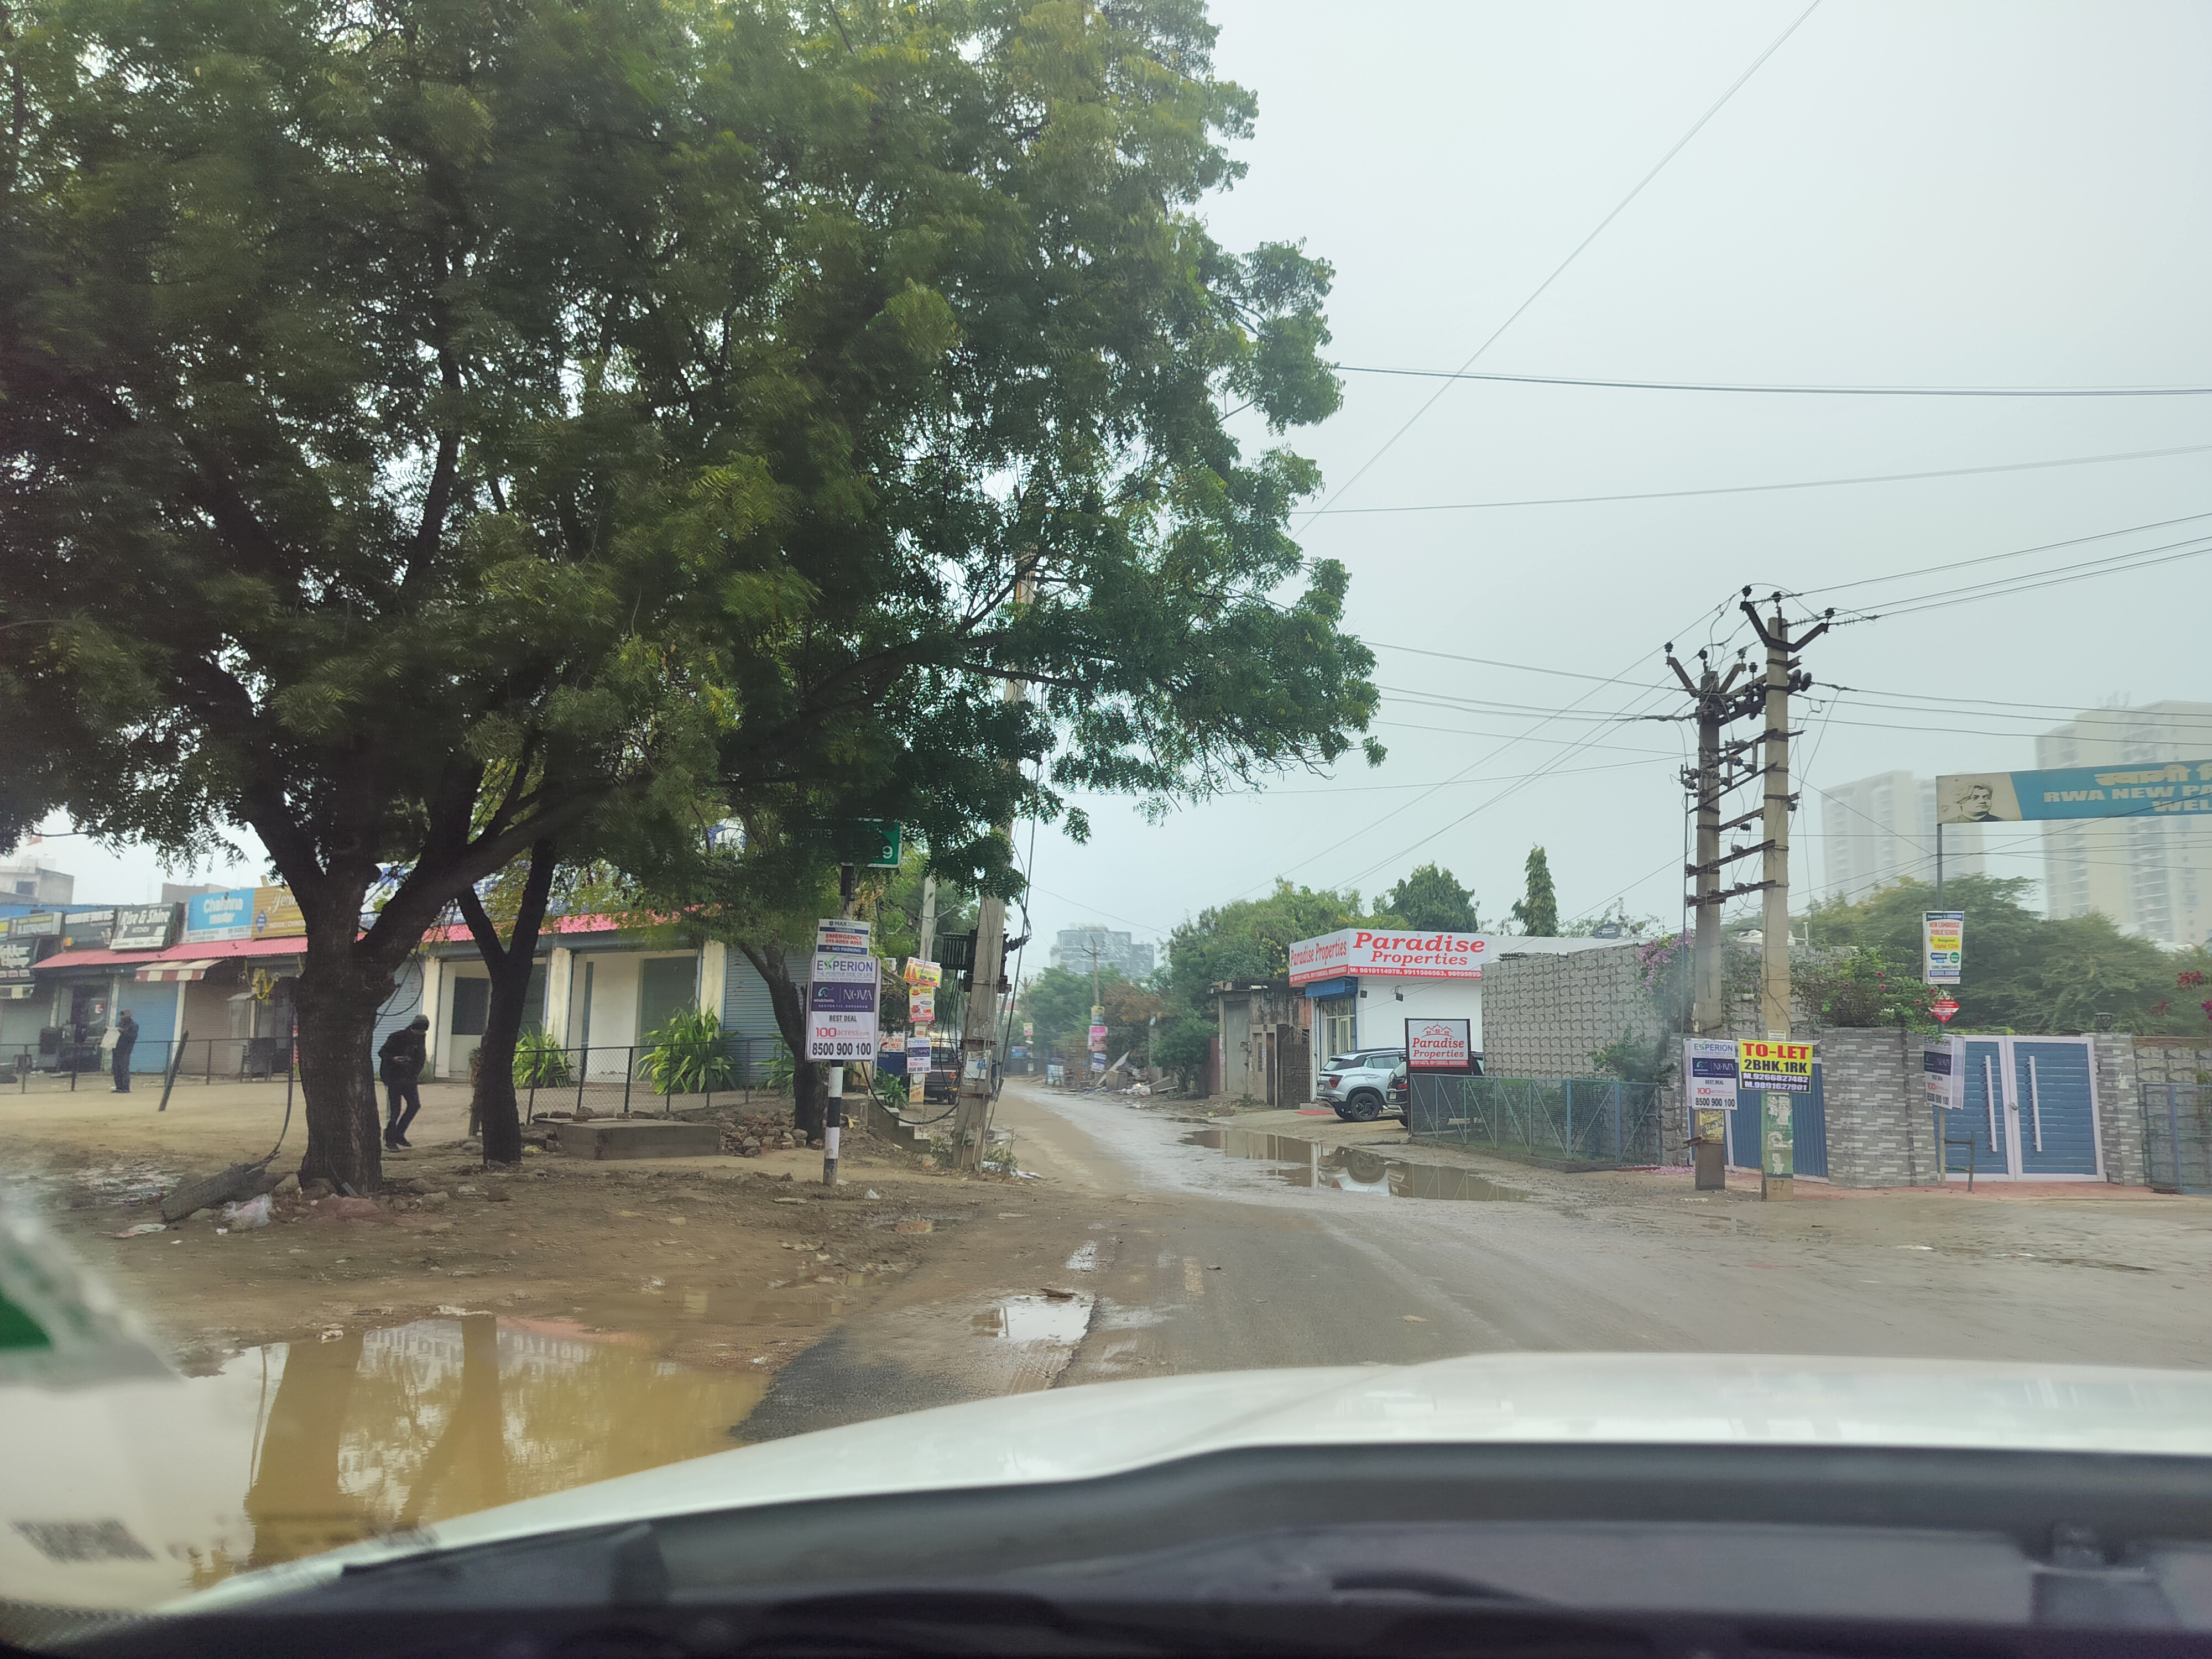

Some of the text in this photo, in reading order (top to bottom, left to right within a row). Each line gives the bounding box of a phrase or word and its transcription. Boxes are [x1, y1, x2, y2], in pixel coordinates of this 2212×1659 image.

[2043, 790, 2106, 802] RWA
[2112, 786, 2174, 800] NEW
[120, 911, 139, 926] Rise
[138, 910, 147, 924] &
[147, 908, 170, 924] Shine
[1353, 932, 1485, 953] Paradise
[1290, 937, 1347, 967] Paradise Properties
[1370, 950, 1468, 967] Properties
[817, 957, 873, 972] EXPERION
[843, 988, 873, 1000] NOVA
[812, 1042, 834, 1056] 8500
[836, 1042, 853, 1056] 900
[856, 1042, 872, 1056] 100
[1412, 1037, 1464, 1048] Paradise
[1694, 1042, 1733, 1052] EXPERION
[1413, 1050, 1464, 1059] Properties
[1743, 1042, 1809, 1060] TO-LET
[1713, 1062, 1735, 1071] NOVA
[1744, 1058, 1808, 1073] 2BHK,1RK
[1743, 1072, 1808, 1083] M.9266827482
[1744, 1081, 1807, 1091] M.9891627901
[1695, 1097, 1735, 1107] 8500 900 100
